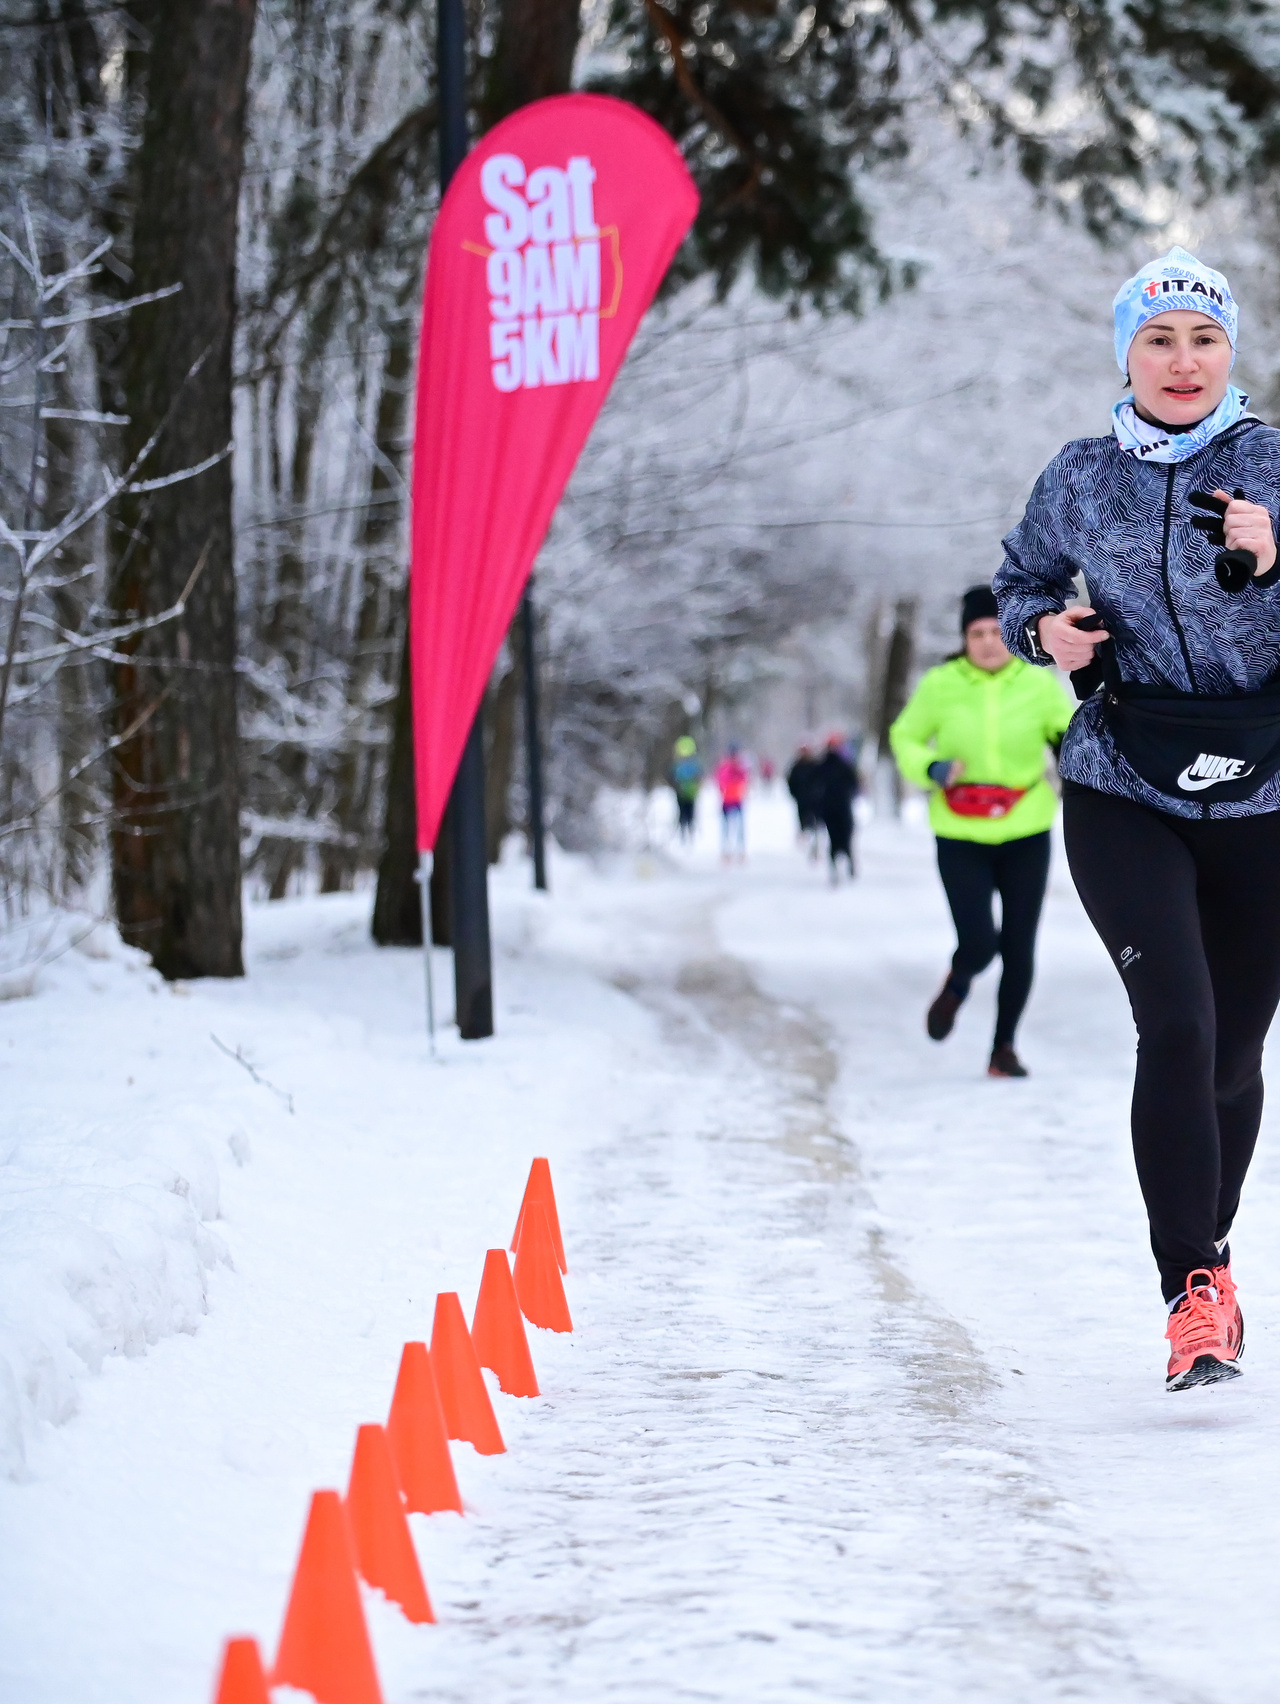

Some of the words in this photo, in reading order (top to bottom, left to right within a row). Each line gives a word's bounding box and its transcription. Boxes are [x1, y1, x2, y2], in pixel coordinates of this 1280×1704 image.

[481, 153, 599, 249] Sat
[487, 241, 600, 319] 9AM
[1144, 279, 1223, 306] TITAN
[490, 312, 600, 392] 5KM
[1190, 753, 1246, 778] NIKE
